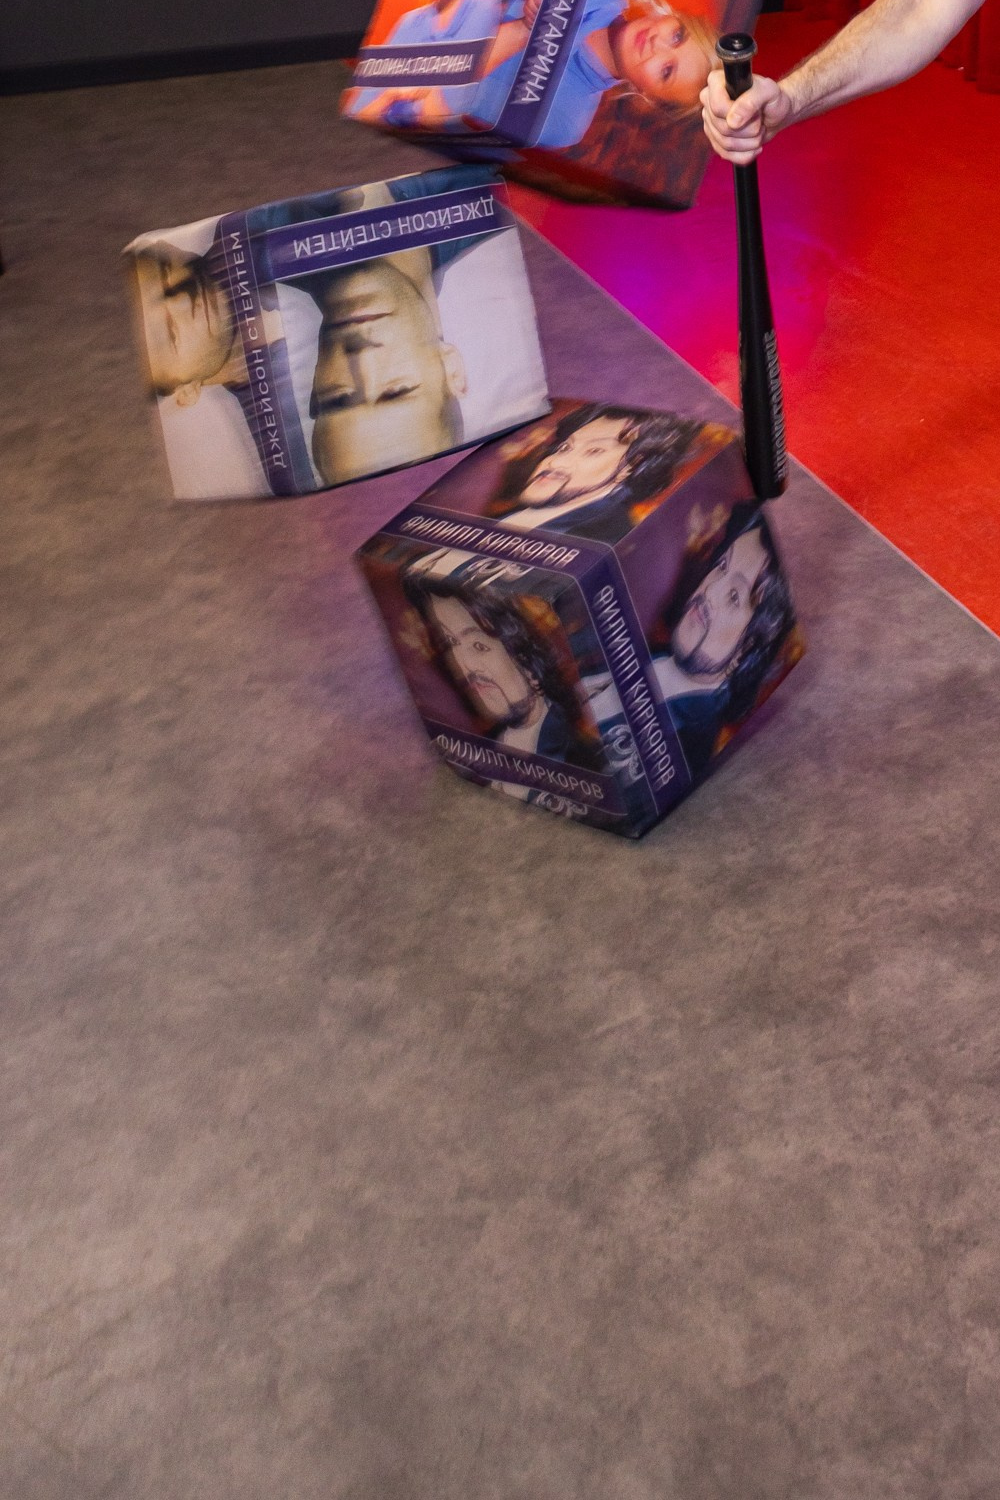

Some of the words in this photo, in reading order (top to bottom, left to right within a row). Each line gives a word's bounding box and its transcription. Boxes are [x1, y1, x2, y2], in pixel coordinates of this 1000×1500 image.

[293, 220, 392, 258] СТЕЙТЕМ
[399, 194, 494, 235] ДЖЕЙСОН
[229, 231, 259, 341] СТЕЙТЕМ
[251, 348, 287, 469] ДЖЕЙСОН
[404, 515, 485, 546] ФИЛИПП
[475, 531, 580, 568] КИРКОРОВ
[597, 585, 640, 686] ФИЛИПП
[625, 676, 675, 790] КИРКОРОВ
[436, 734, 509, 768] ФИЛИПП
[512, 757, 604, 799] КИРКОРОВ
